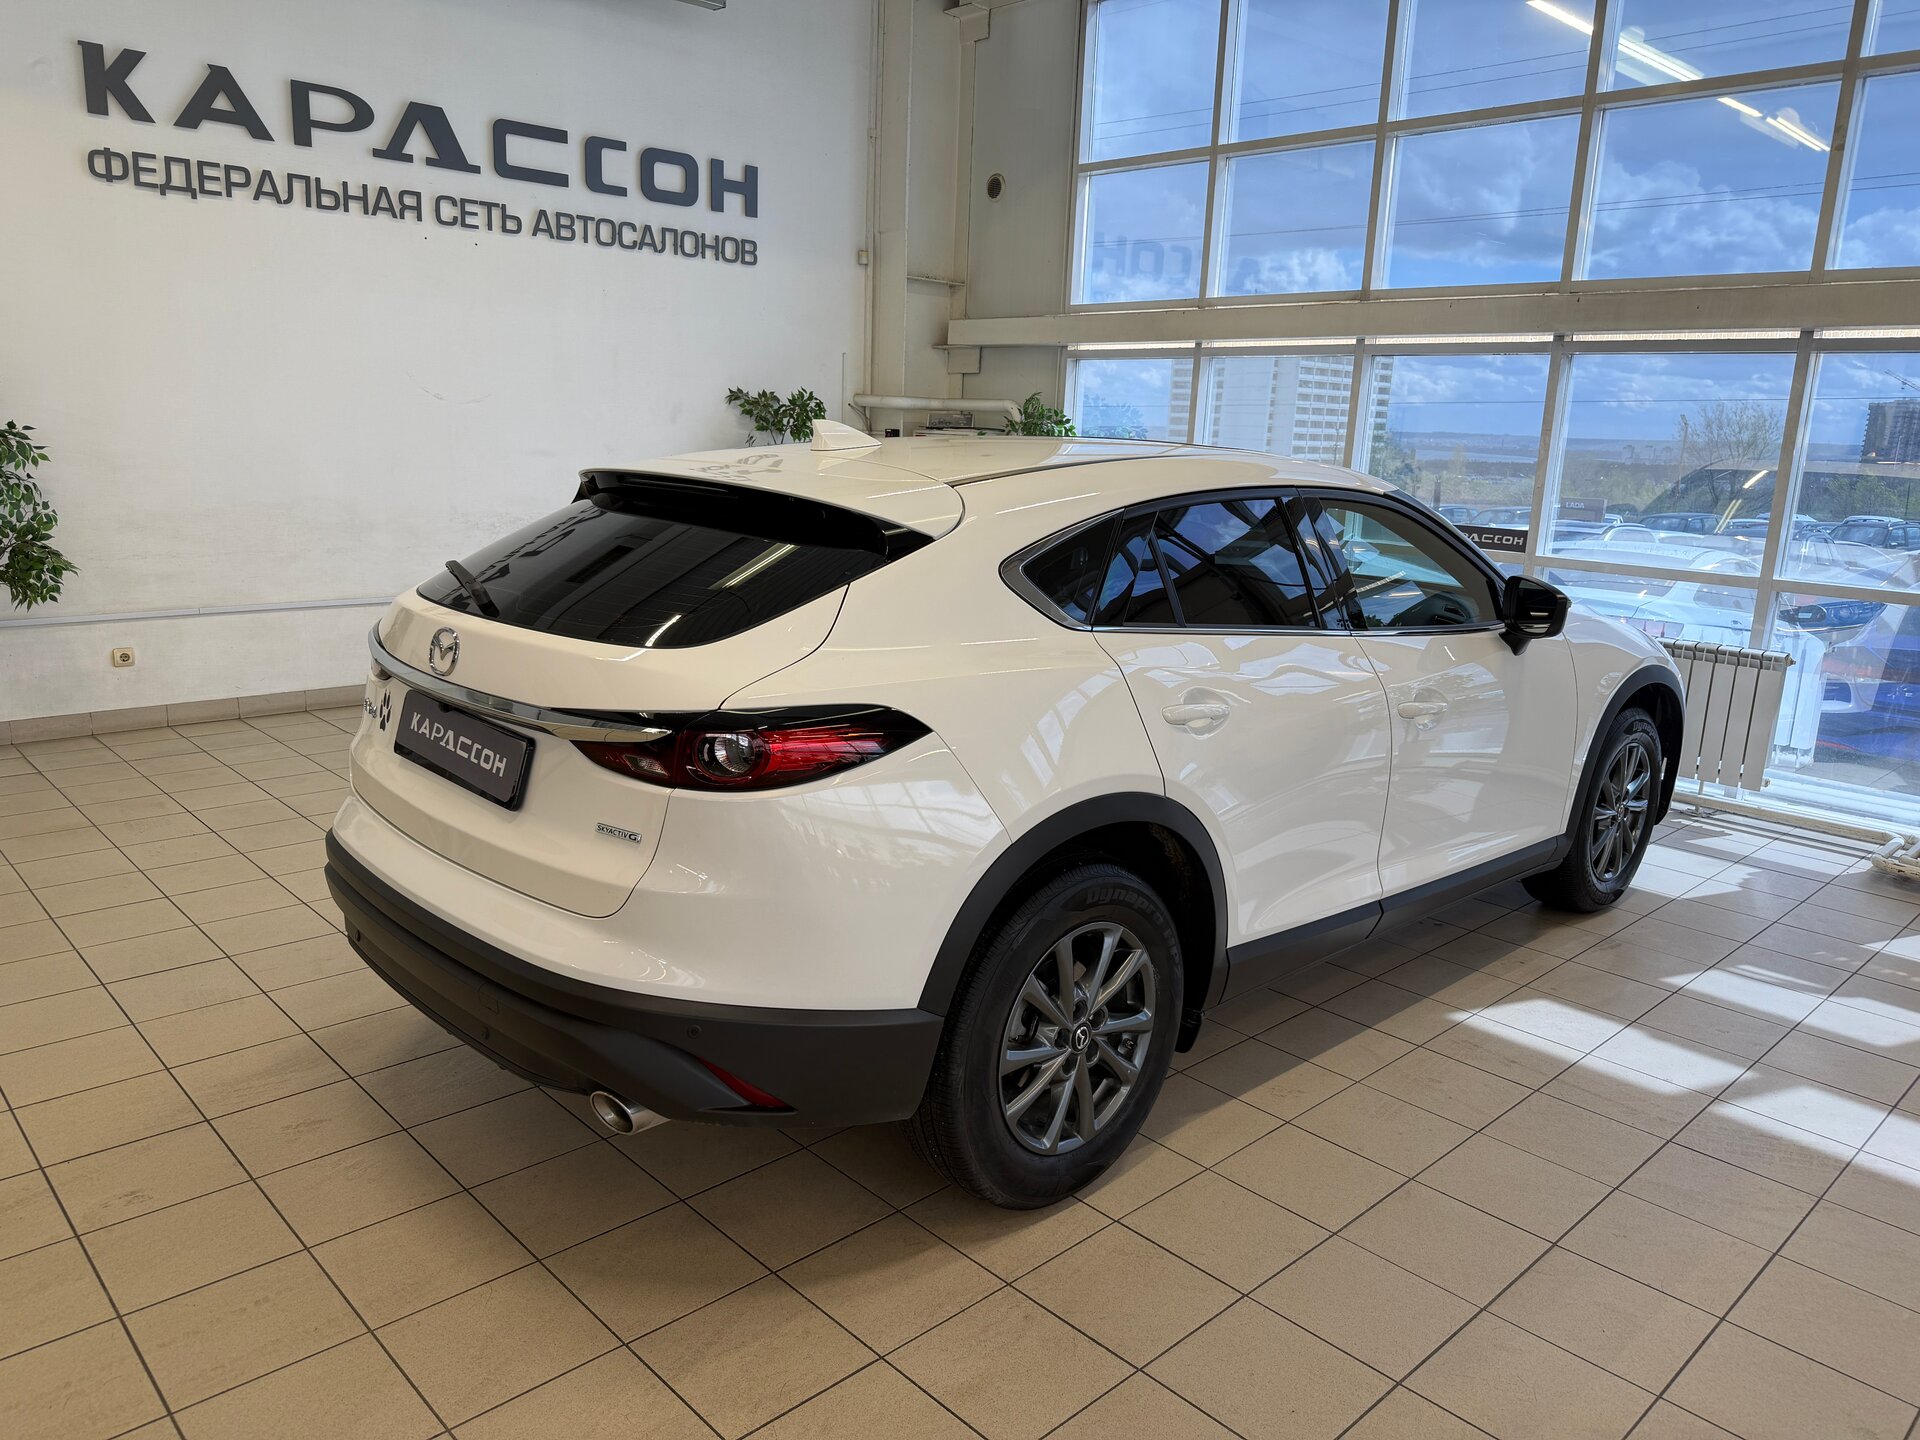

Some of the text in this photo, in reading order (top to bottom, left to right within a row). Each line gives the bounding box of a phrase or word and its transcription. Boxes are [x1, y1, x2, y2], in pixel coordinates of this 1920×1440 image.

[77, 39, 759, 219] КАРАССОН
[86, 146, 759, 266] ФЕДЕРАЛЬНАЯ СЕТЬ АВТОСАЛОНОВ
